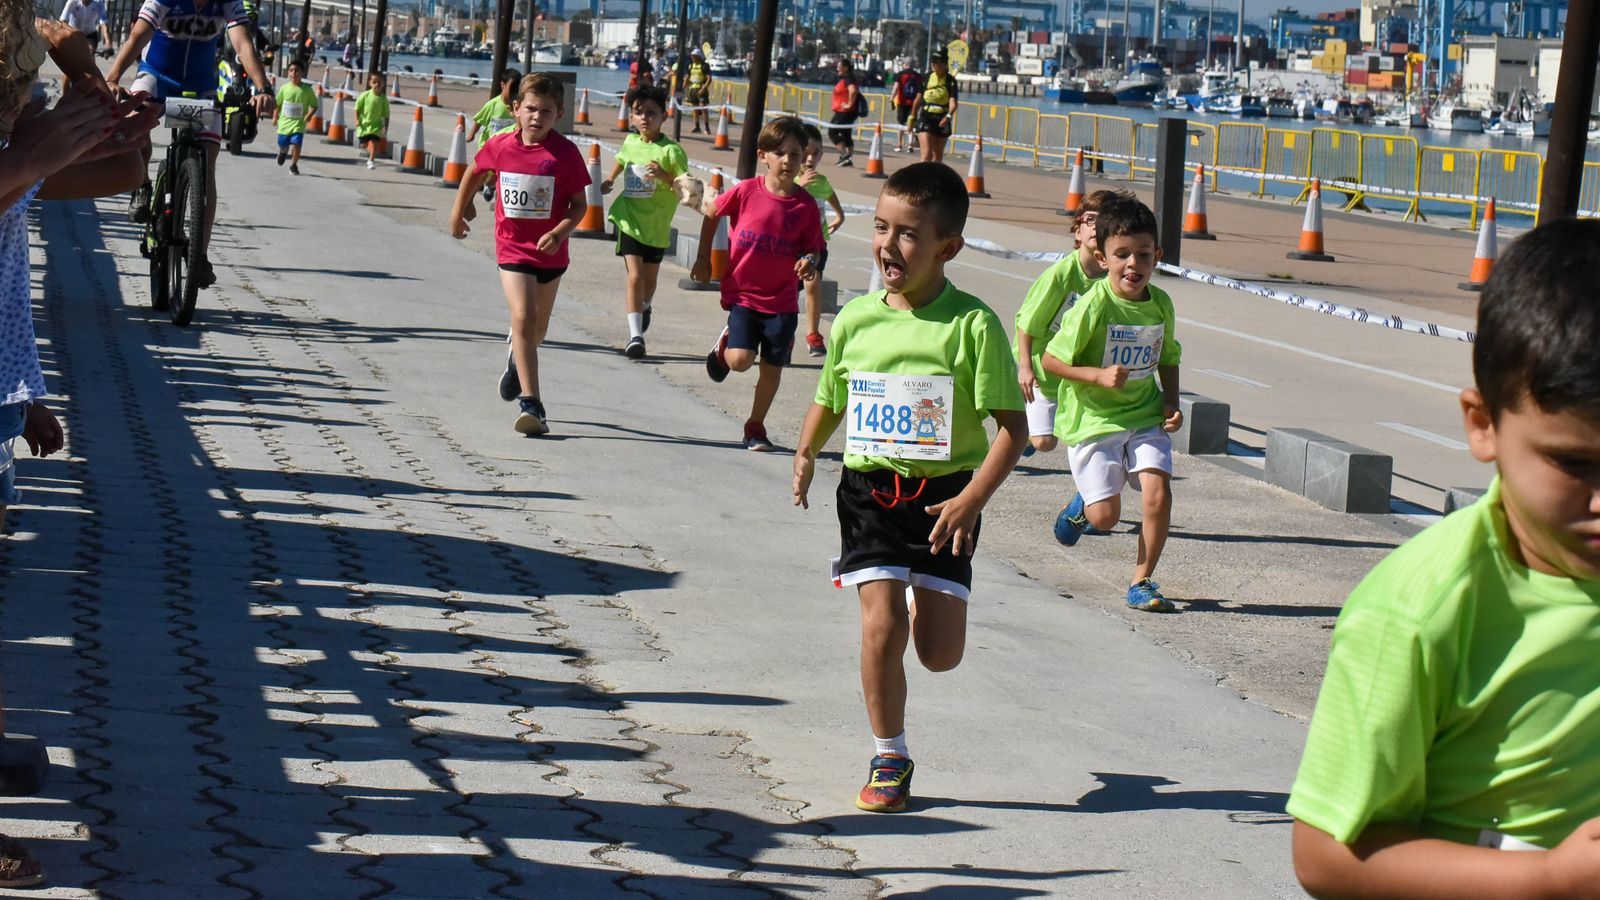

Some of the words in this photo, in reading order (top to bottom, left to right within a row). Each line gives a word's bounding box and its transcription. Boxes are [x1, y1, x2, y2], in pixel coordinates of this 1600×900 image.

[504, 189, 528, 206] 830
[1110, 345, 1153, 366] 1078
[852, 379, 868, 393] XXI
[853, 402, 912, 435] 1488
